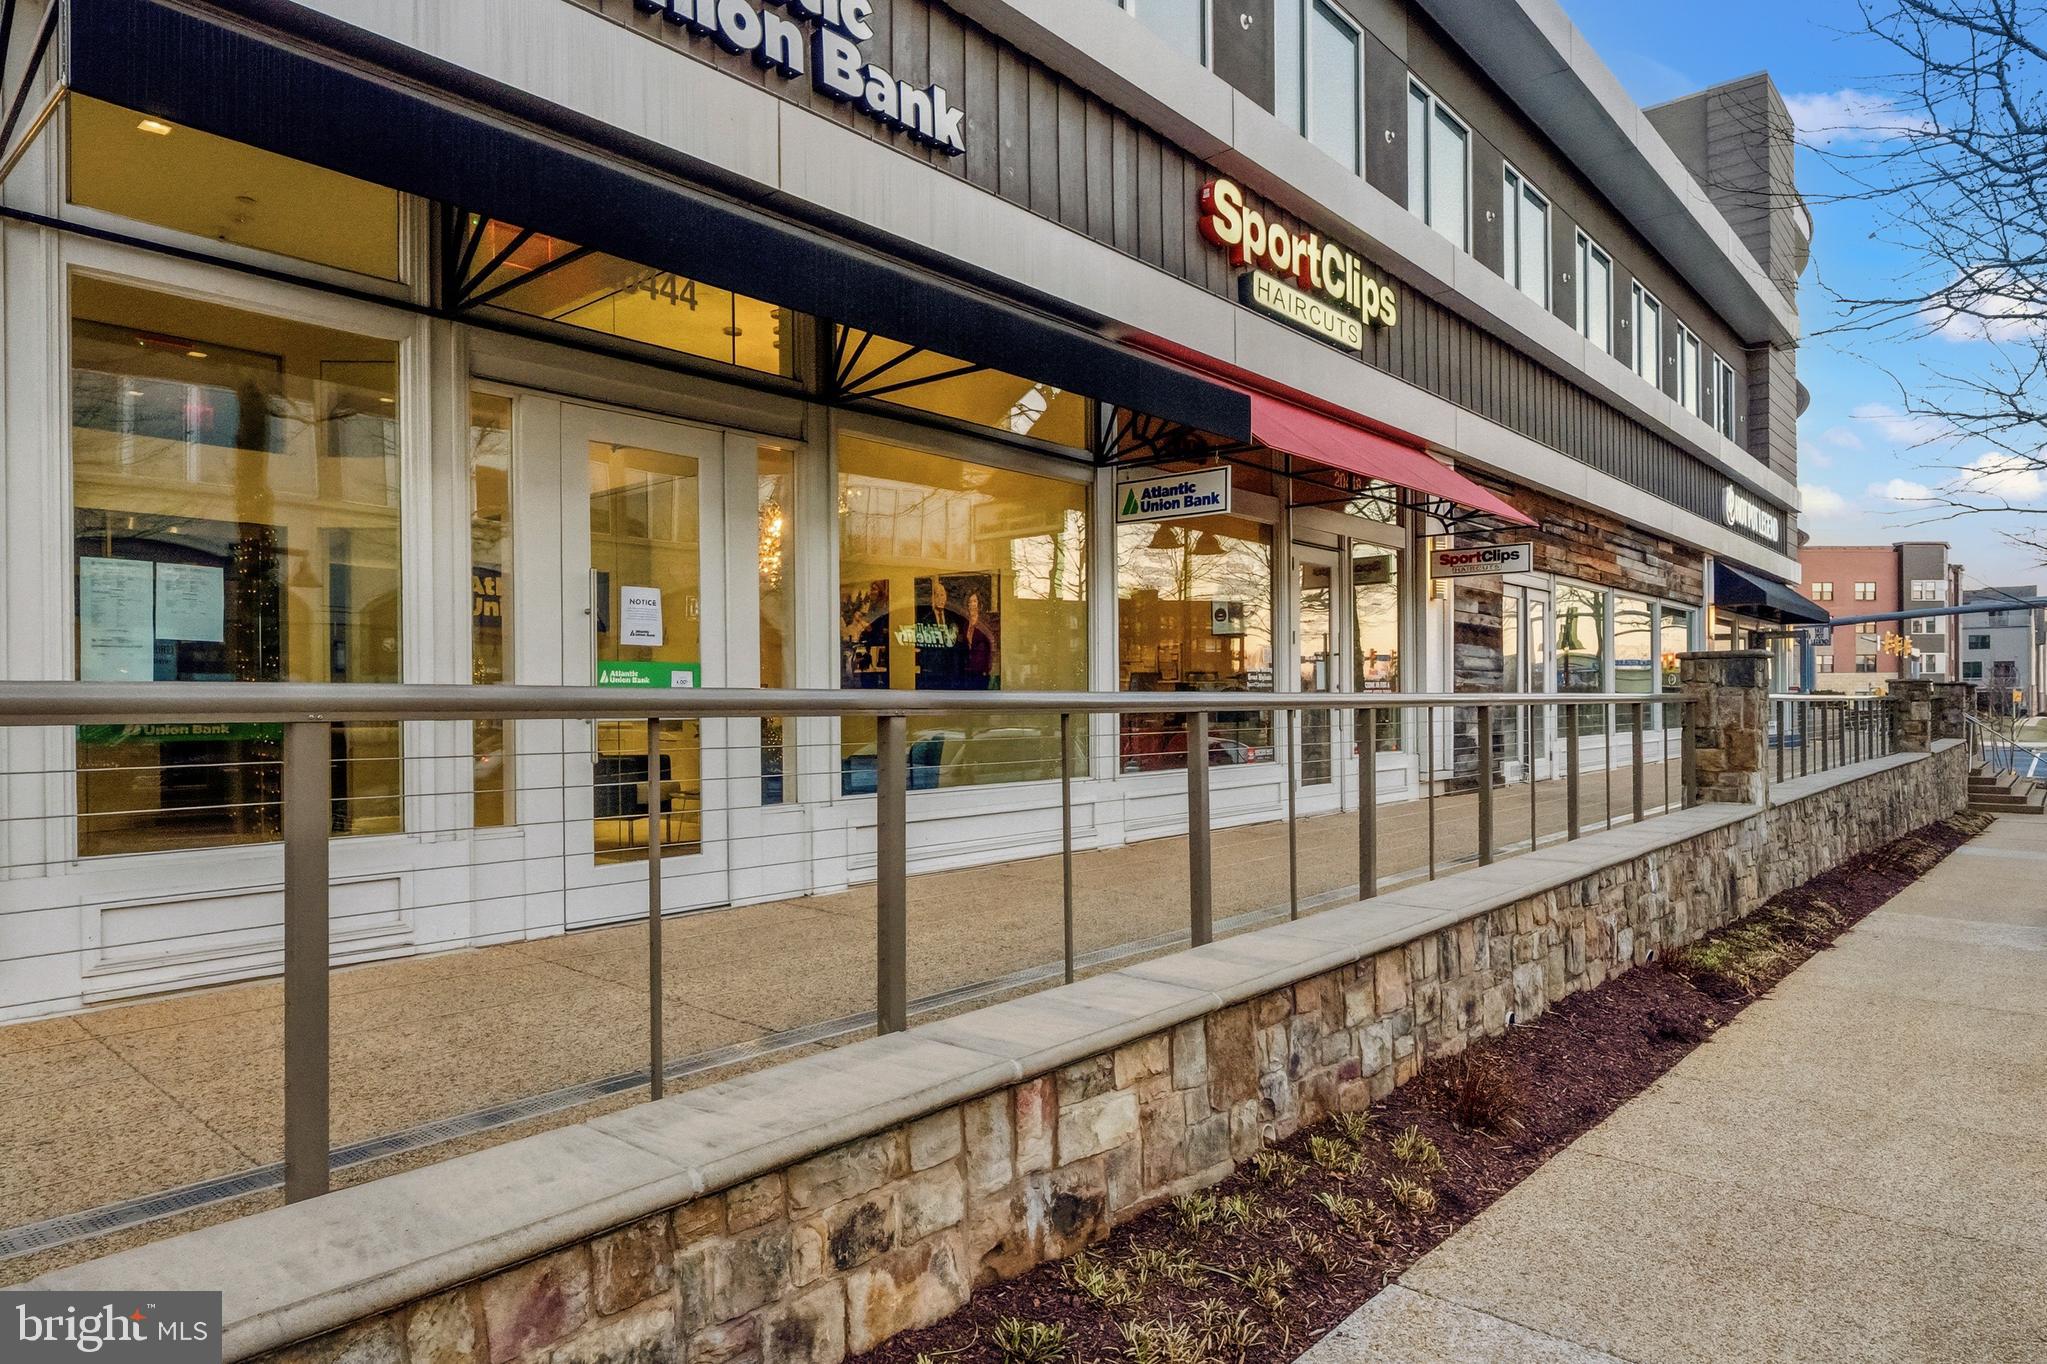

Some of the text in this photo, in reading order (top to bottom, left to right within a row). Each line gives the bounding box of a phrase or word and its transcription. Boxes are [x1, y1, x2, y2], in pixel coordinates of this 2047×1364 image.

[822, 26, 966, 152] Bank
[1210, 178, 1397, 328] SportClips
[1257, 277, 1358, 344] HAIRCUTS
[1141, 481, 1196, 501] Atlantic
[1141, 491, 1220, 513] Union Bank
[1439, 549, 1520, 567] SportClips
[629, 598, 657, 607] NOTICE
[609, 670, 638, 678] Atlantic
[143, 724, 230, 735] Union Bank
